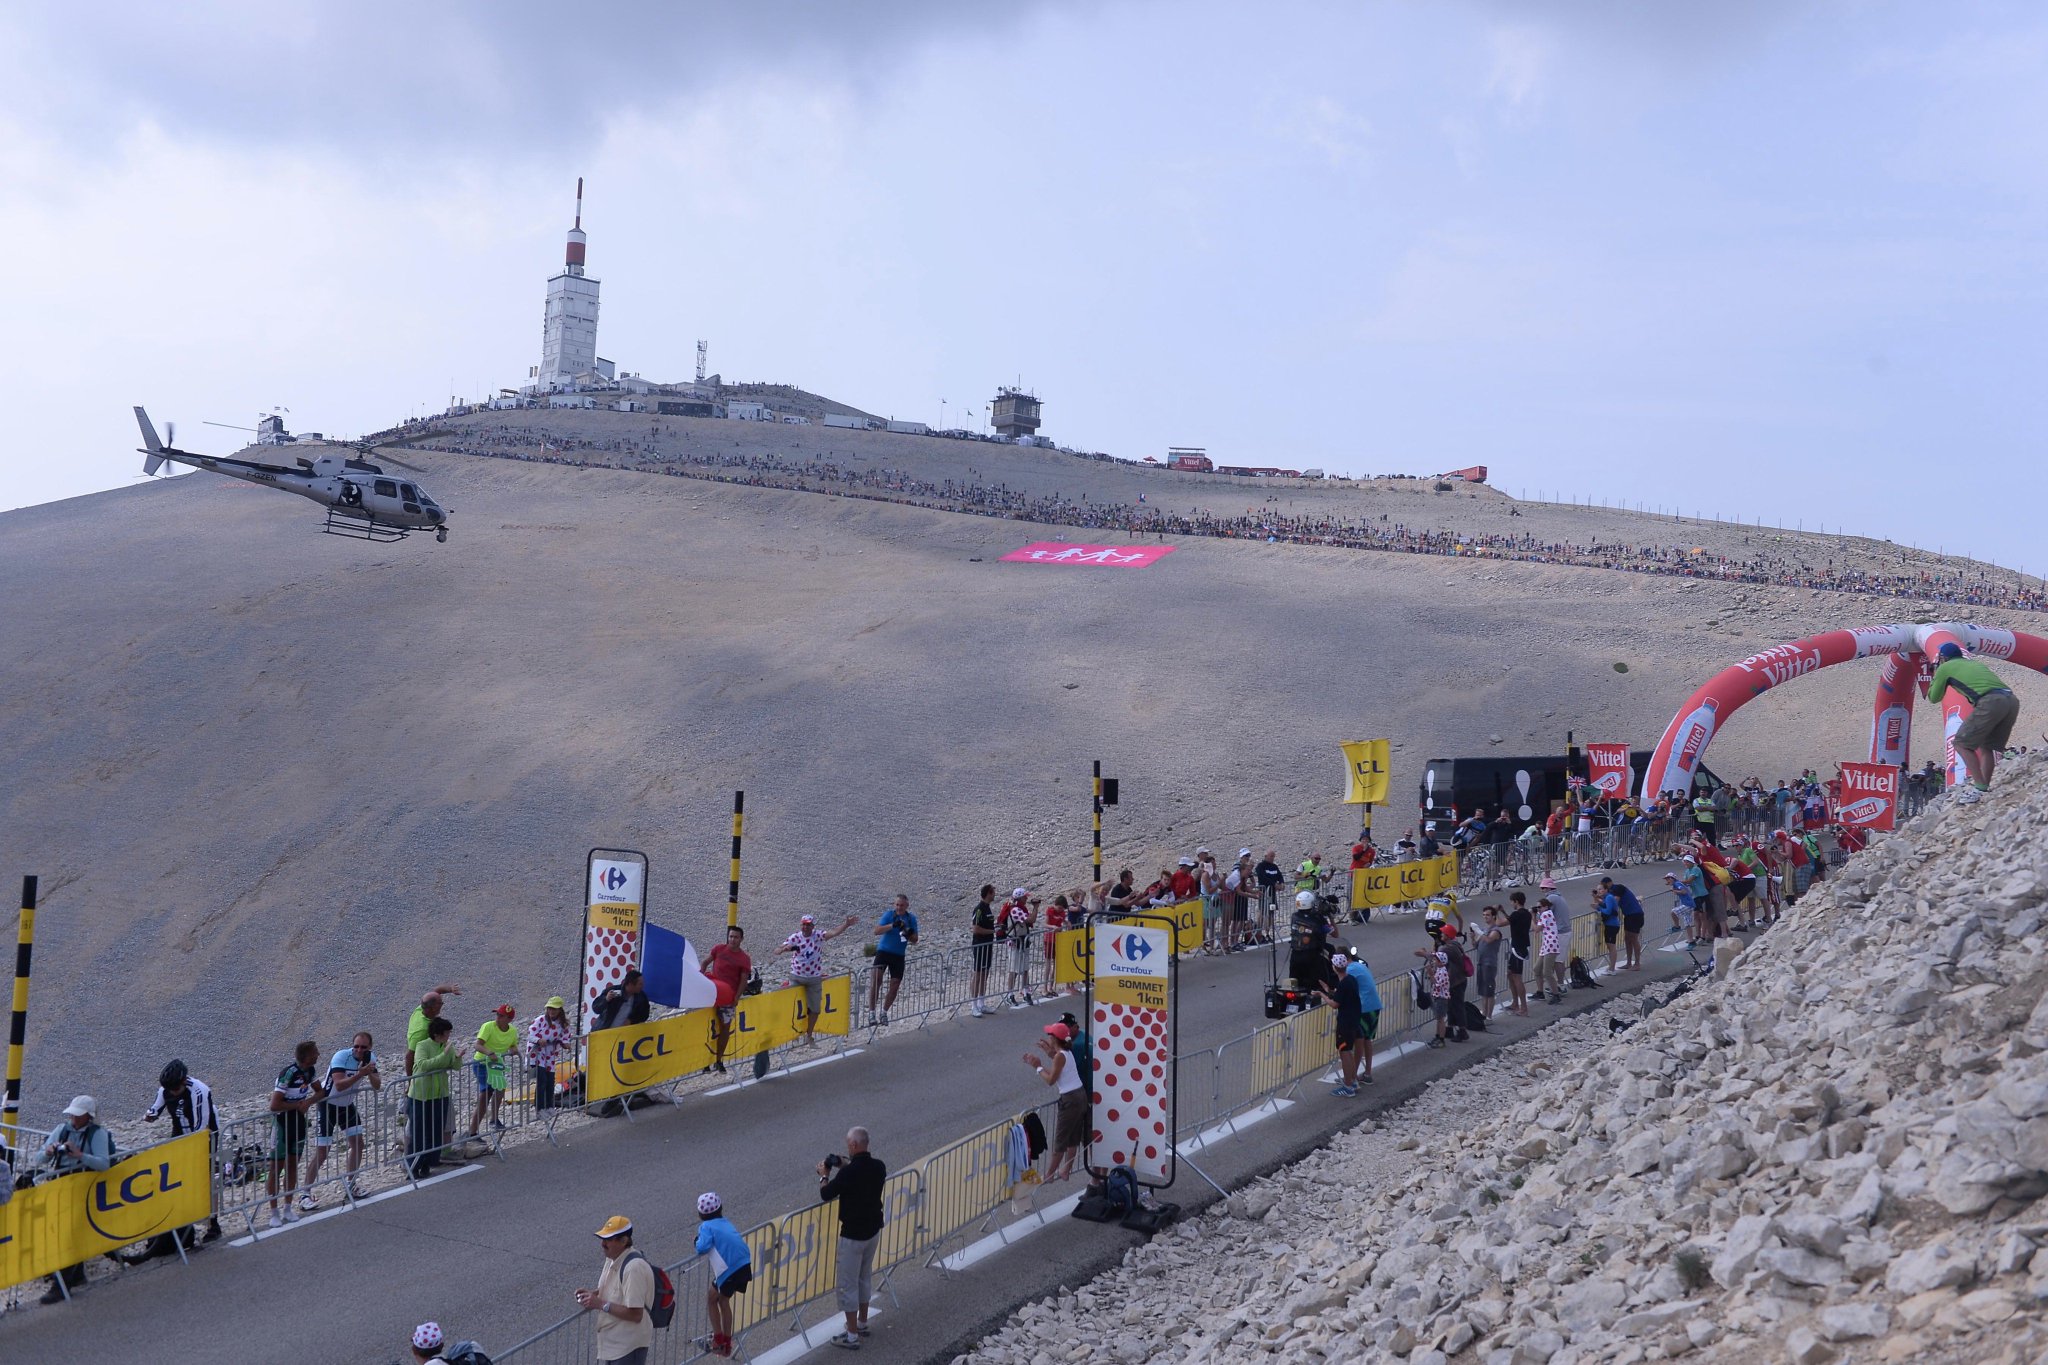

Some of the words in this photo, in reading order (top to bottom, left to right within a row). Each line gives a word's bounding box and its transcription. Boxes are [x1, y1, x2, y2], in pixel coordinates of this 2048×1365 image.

[246, 471, 277, 482] F-GZEN
[1869, 643, 1902, 656] Vittel
[1978, 638, 2012, 656] Vittel
[1761, 648, 1822, 687] Vittel
[1921, 663, 1927, 675] 1
[1918, 673, 1932, 682] km
[1888, 719, 1900, 739] Vittel
[1683, 725, 1706, 755] Vittel
[1589, 749, 1626, 767] Vittel
[1357, 760, 1384, 775] LCL
[1843, 769, 1894, 793] Vittel
[1851, 804, 1875, 818] Vittel
[1441, 861, 1453, 876] LCL
[1367, 875, 1390, 890] LCL
[1401, 869, 1425, 884] LCL
[597, 892, 627, 902] Carrefour
[601, 906, 634, 917] SOMMET
[613, 916, 633, 927] 1km
[1110, 963, 1153, 975] Carrefour
[1118, 979, 1164, 993] SOMMET
[1137, 992, 1164, 1005] 1km
[796, 993, 837, 1020] LL
[710, 1011, 756, 1040] LL
[616, 1034, 672, 1064] LCL
[96, 1162, 182, 1213] LCL
